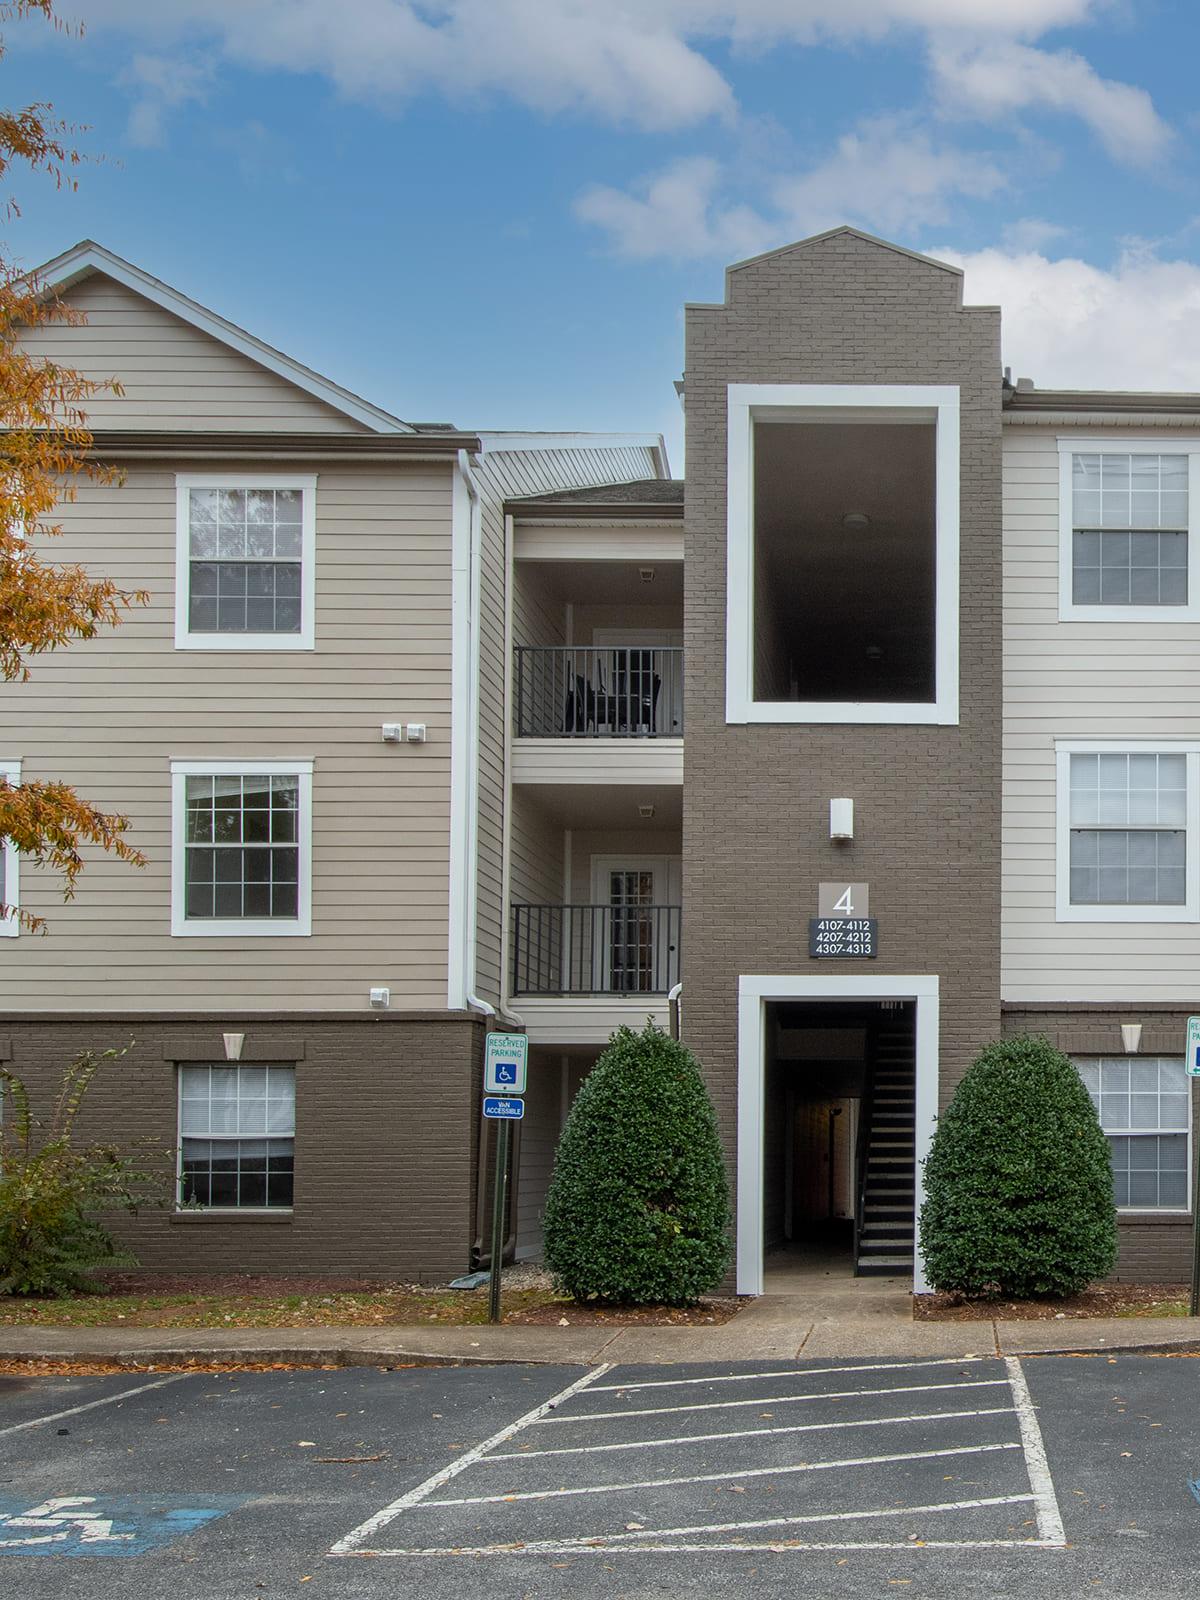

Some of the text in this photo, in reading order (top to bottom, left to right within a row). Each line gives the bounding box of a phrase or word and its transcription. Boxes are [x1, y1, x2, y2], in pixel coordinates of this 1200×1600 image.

[832, 886, 855, 915] 4
[818, 921, 870, 931] 4107-4112
[816, 932, 872, 942] 4207-4212
[816, 944, 872, 954] 4307-4313
[489, 1038, 525, 1048] RESERVED
[491, 1049, 522, 1058] PARKING
[486, 1107, 521, 1115] ACCESSIBLE
